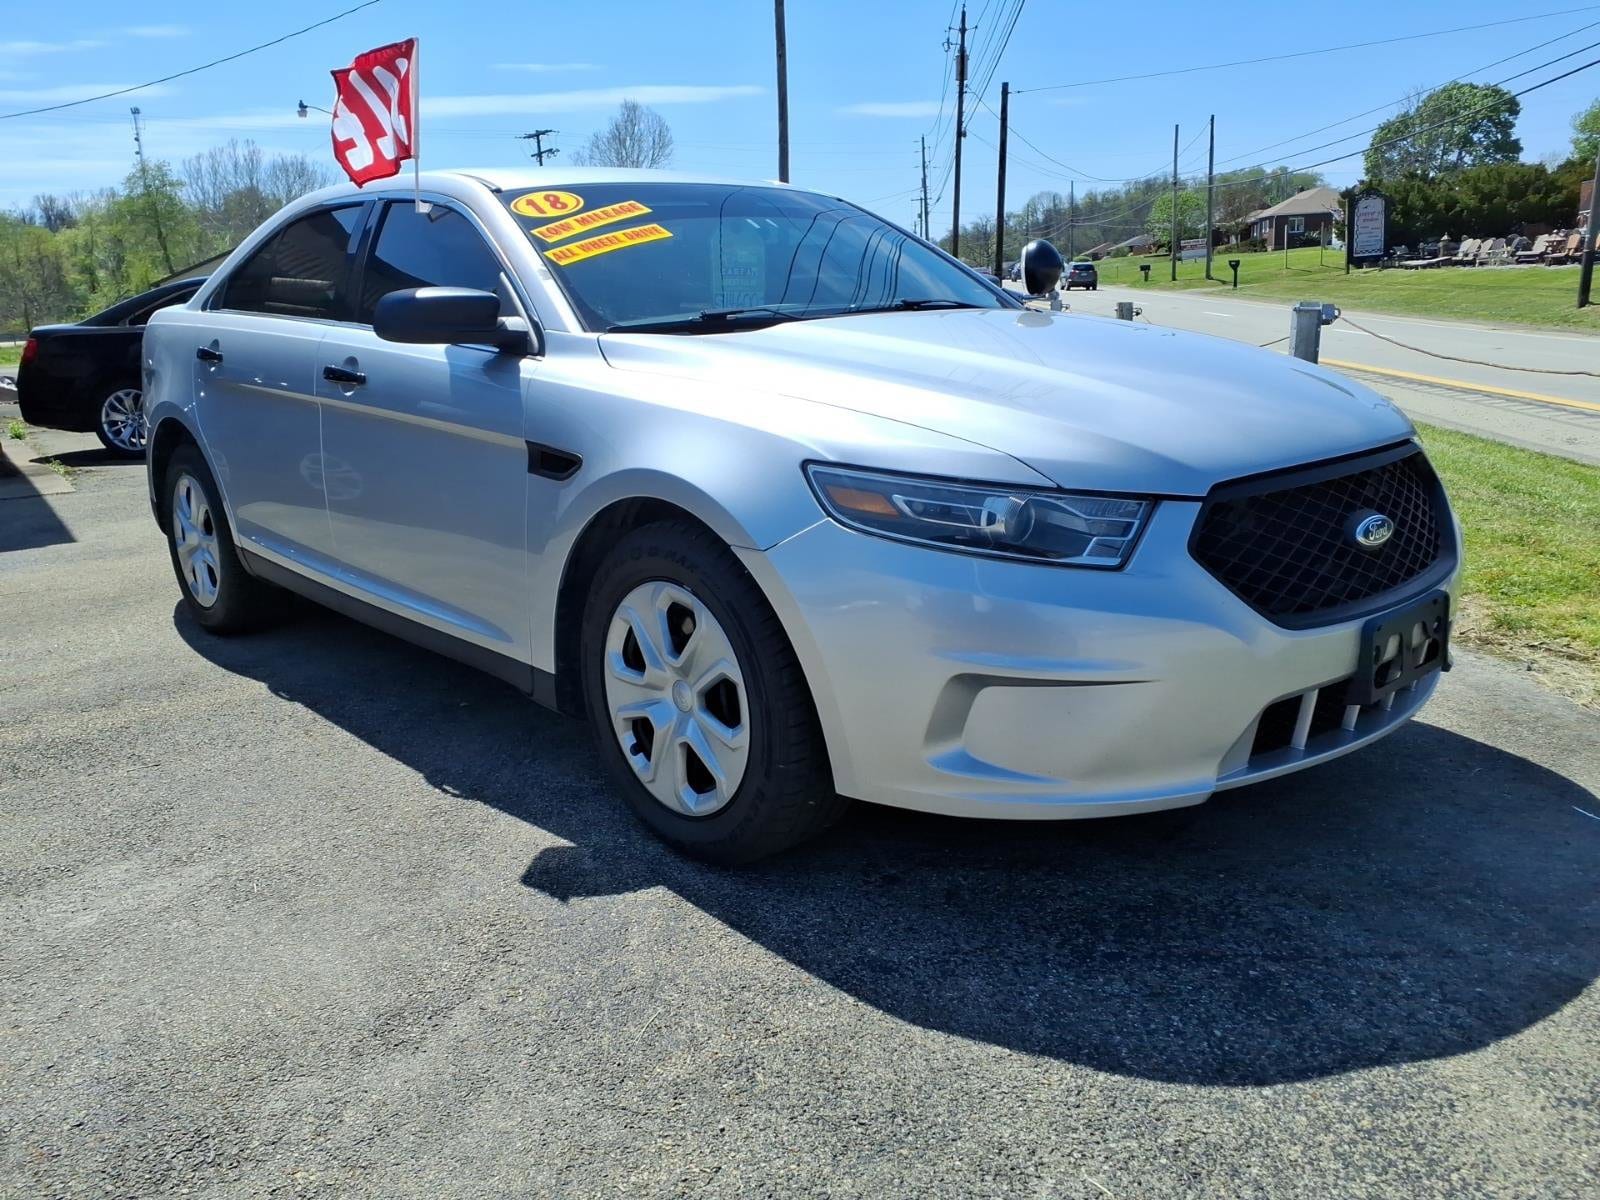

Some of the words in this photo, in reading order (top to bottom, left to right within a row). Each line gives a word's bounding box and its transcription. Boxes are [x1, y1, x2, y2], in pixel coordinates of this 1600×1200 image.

[525, 193, 569, 215] 18
[537, 221, 576, 239] LOW
[574, 202, 644, 227] MILEAGE
[551, 244, 578, 262] ALL
[576, 234, 624, 253] WHEEL
[622, 226, 664, 241] DRIVE
